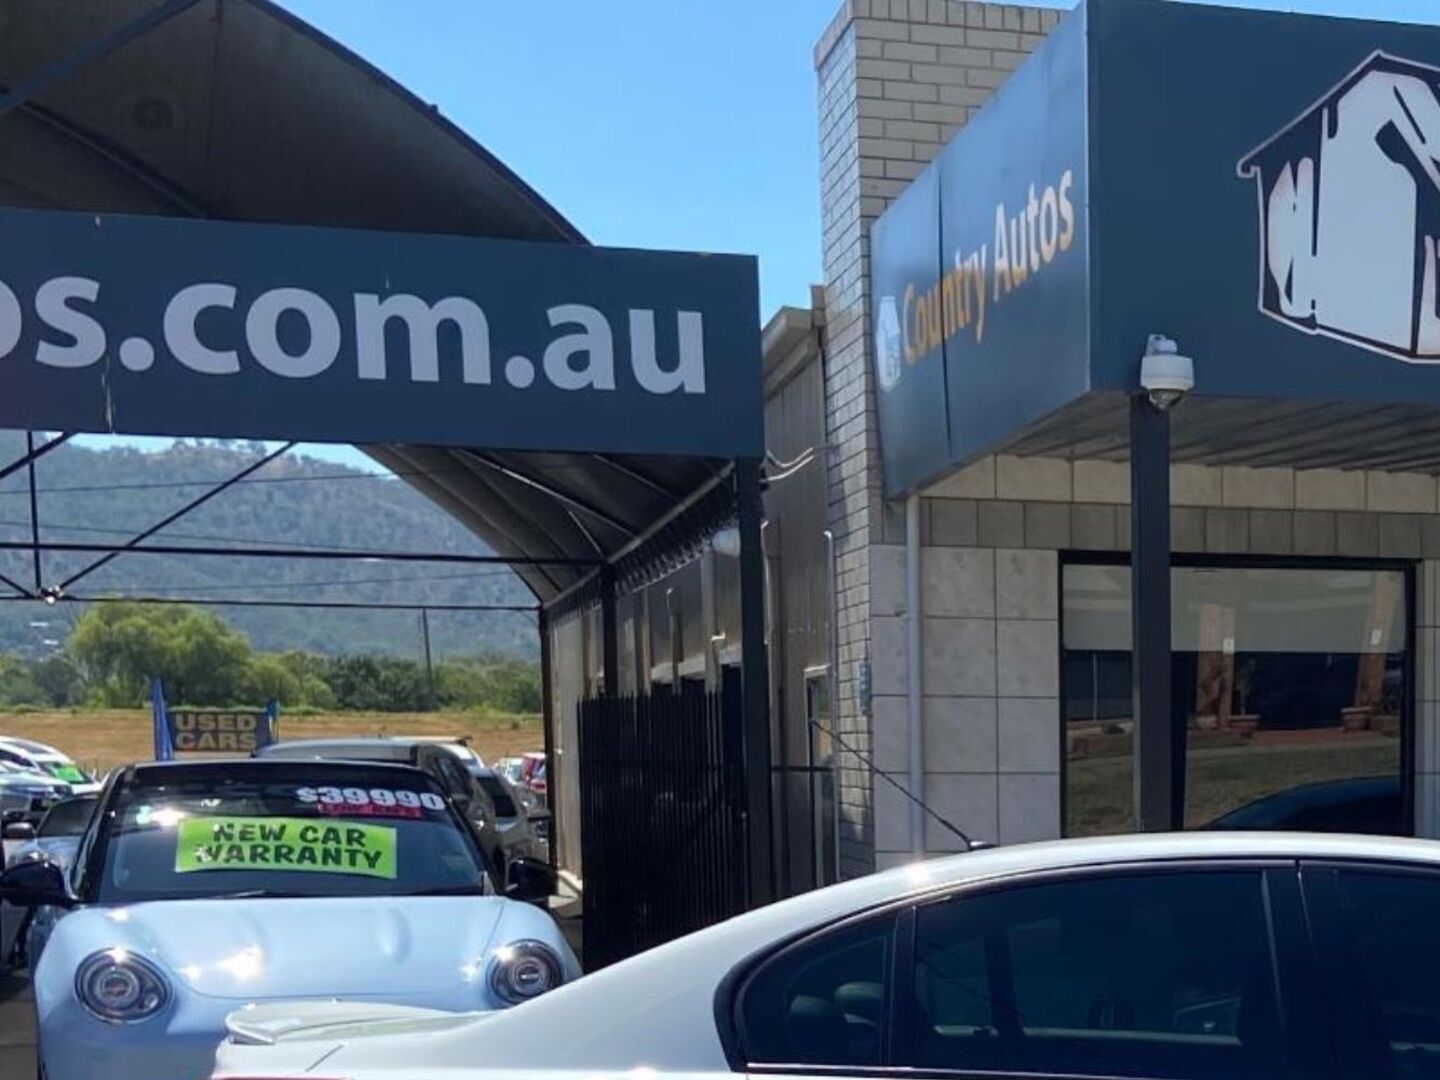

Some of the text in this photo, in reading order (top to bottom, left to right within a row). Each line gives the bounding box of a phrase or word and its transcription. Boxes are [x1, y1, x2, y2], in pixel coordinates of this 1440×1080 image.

[902, 168, 1076, 367] Country Autos
[0, 275, 706, 394] s.com.au
[175, 713, 257, 731] USED
[175, 732, 257, 750] CARS
[296, 786, 446, 811] $39990
[213, 823, 367, 848] NEW CAR
[196, 843, 383, 870] WARRANTY
